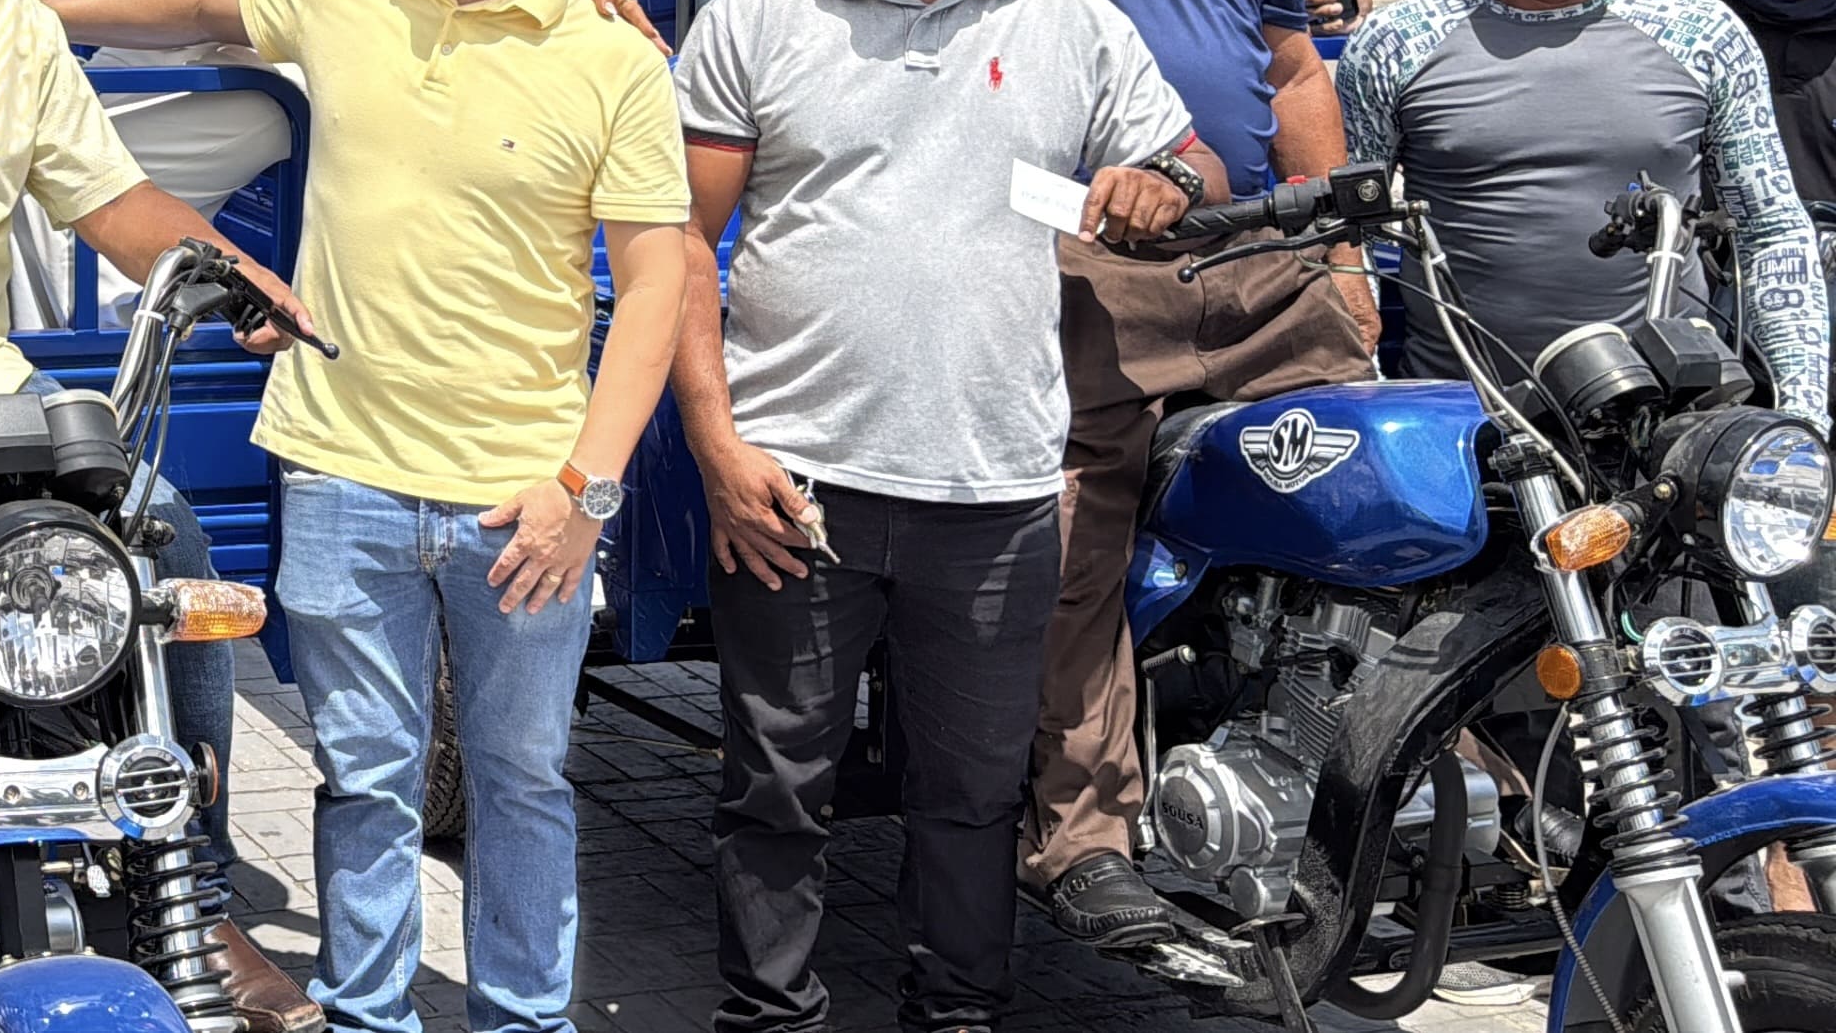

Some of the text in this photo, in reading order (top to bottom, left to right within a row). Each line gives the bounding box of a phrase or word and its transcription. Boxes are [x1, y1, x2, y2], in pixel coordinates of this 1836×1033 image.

[1672, 20, 1704, 36] STOP
[1761, 256, 1804, 275] LIMIT
[1271, 418, 1310, 467] SM
[1161, 802, 1203, 829] SOUSA
